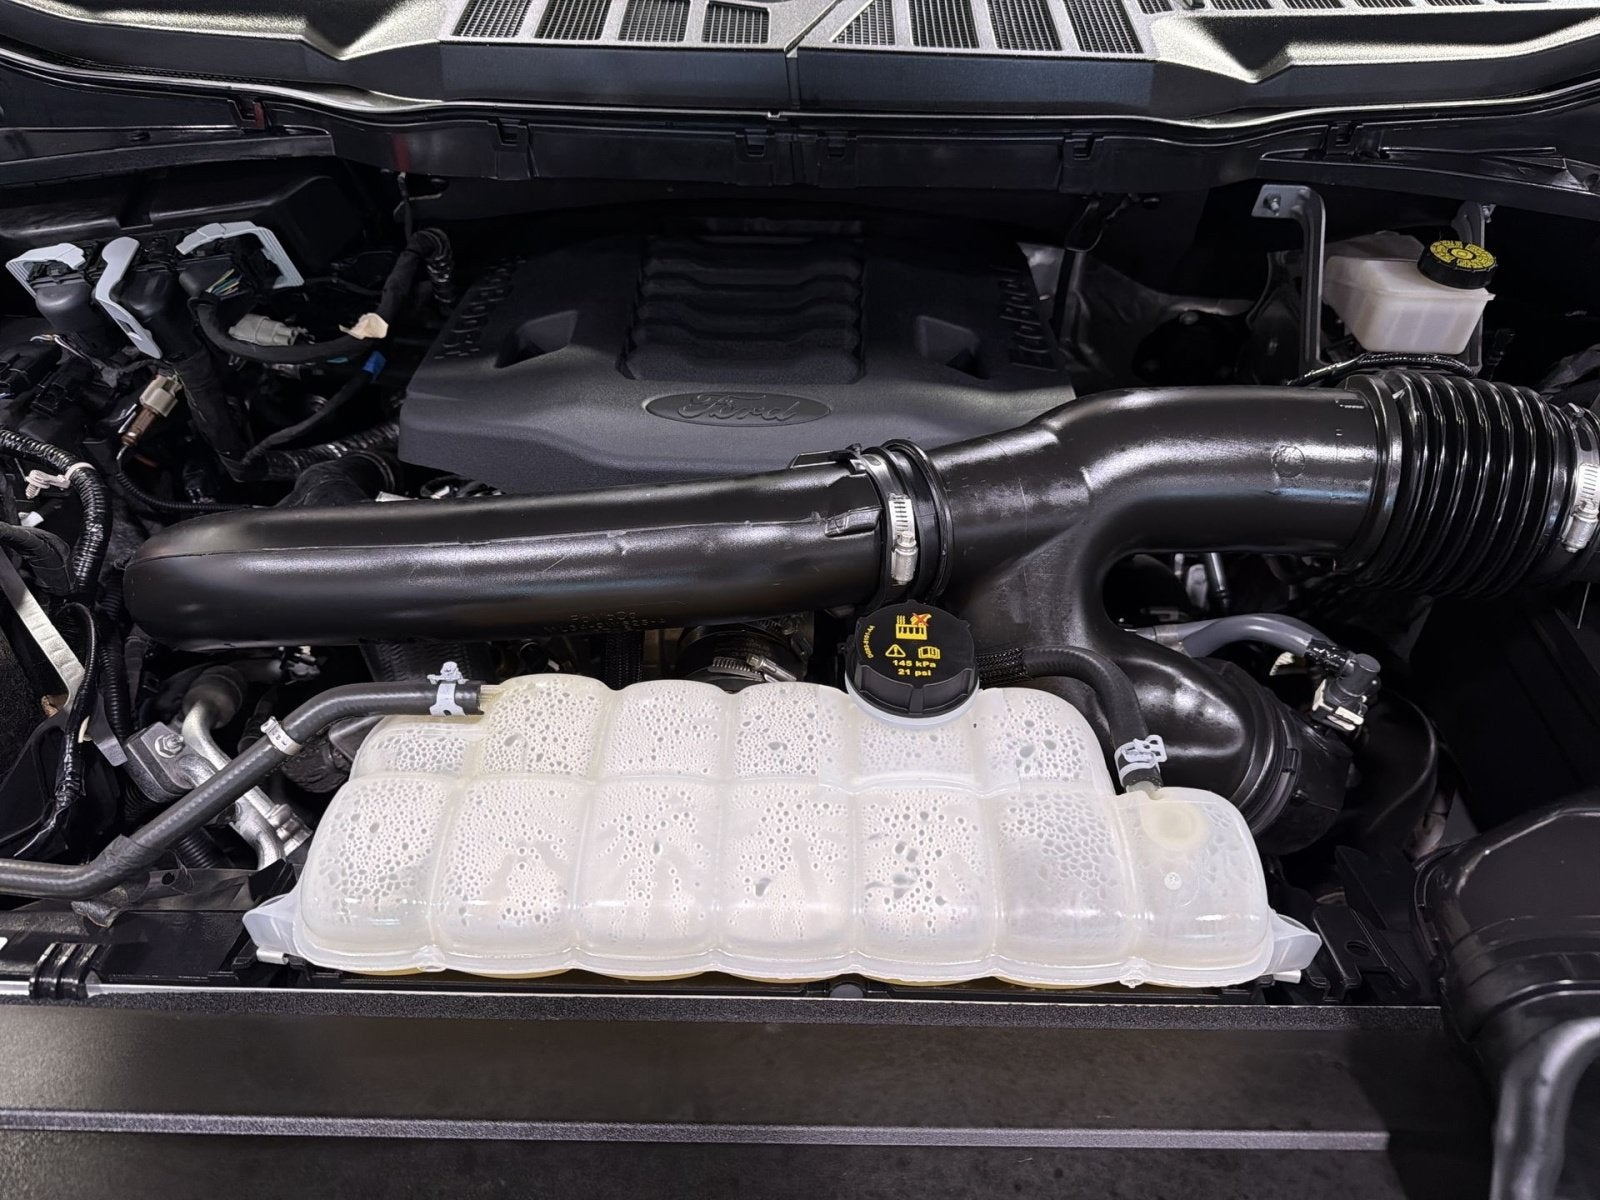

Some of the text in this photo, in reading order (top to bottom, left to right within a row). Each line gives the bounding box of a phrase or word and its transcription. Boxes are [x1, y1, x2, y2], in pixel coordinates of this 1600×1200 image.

[677, 393, 801, 422] Ford
[892, 659, 937, 668] 145 kPa
[897, 668, 932, 677] 21 psi
